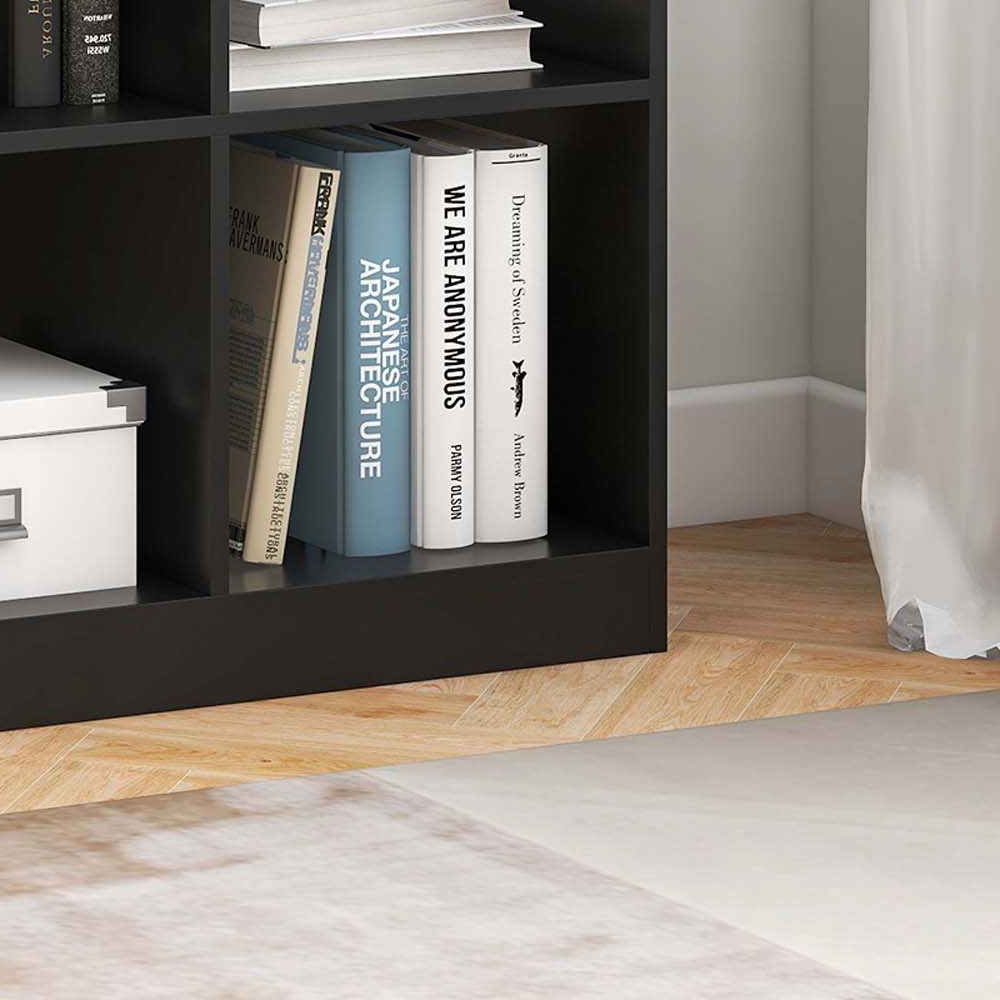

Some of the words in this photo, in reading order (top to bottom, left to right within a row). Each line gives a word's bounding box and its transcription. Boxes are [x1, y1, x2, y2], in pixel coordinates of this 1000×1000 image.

[311, 171, 334, 236] FRANK
[444, 184, 466, 219] WE
[444, 225, 466, 268] ARE
[508, 194, 526, 266] Dreaming
[511, 269, 526, 285] of
[382, 258, 400, 404] JAPANESE
[399, 313, 409, 346] THE
[511, 287, 526, 345] Sweden
[399, 347, 409, 376] ART
[443, 273, 466, 410] ANONYMOUS
[359, 258, 382, 479] ARCHITECTURE
[399, 380, 409, 401] OF
[450, 443, 463, 482] PARMY
[513, 432, 526, 478] Andrew
[450, 484, 463, 520] OLSON
[513, 481, 526, 519] Brown
